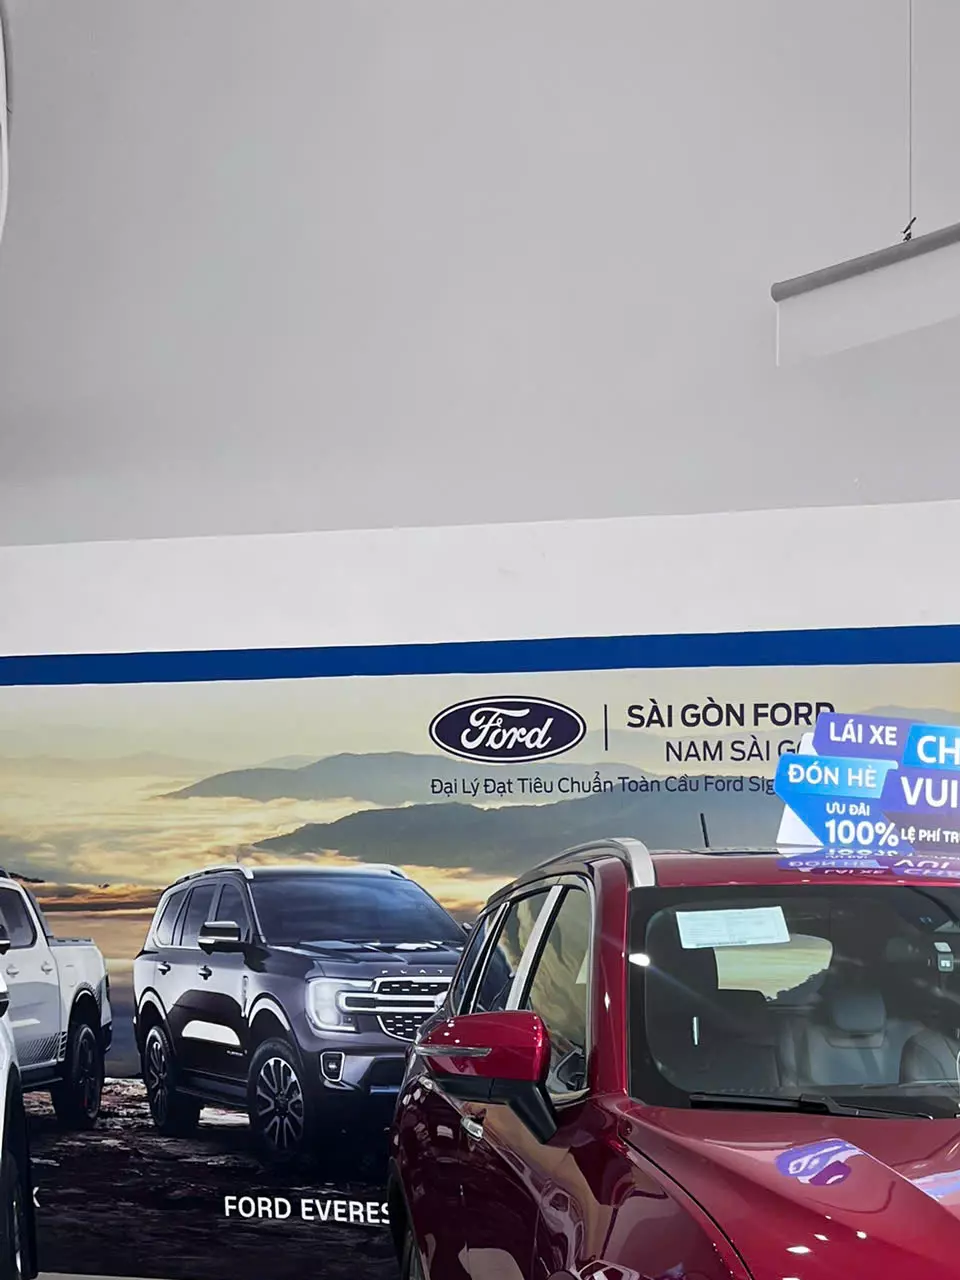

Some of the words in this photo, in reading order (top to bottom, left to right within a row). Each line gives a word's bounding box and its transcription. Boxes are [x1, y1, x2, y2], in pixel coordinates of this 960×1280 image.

[627, 698, 673, 728] SÀI
[680, 697, 745, 727] GÒN
[461, 707, 553, 749] Ford
[830, 719, 863, 744] LÁI
[869, 725, 898, 746] XE
[666, 740, 722, 762] NAM
[730, 735, 770, 762] SÀI
[431, 778, 457, 797] Đại
[462, 777, 480, 797] Lý
[484, 778, 513, 797] Đạt
[517, 777, 554, 794] Tiêu
[558, 771, 613, 793] Chuẩn
[618, 775, 660, 792] Toàn
[665, 773, 700, 792] Cầu
[704, 775, 744, 792] Ford
[788, 760, 840, 786] ĐÓN
[848, 764, 877, 788] HÈ
[901, 776, 959, 808] VUI
[825, 819, 900, 847] 100%
[901, 826, 917, 843] LỆ
[919, 826, 941, 843] PHÍ
[224, 1195, 292, 1219] FORD
